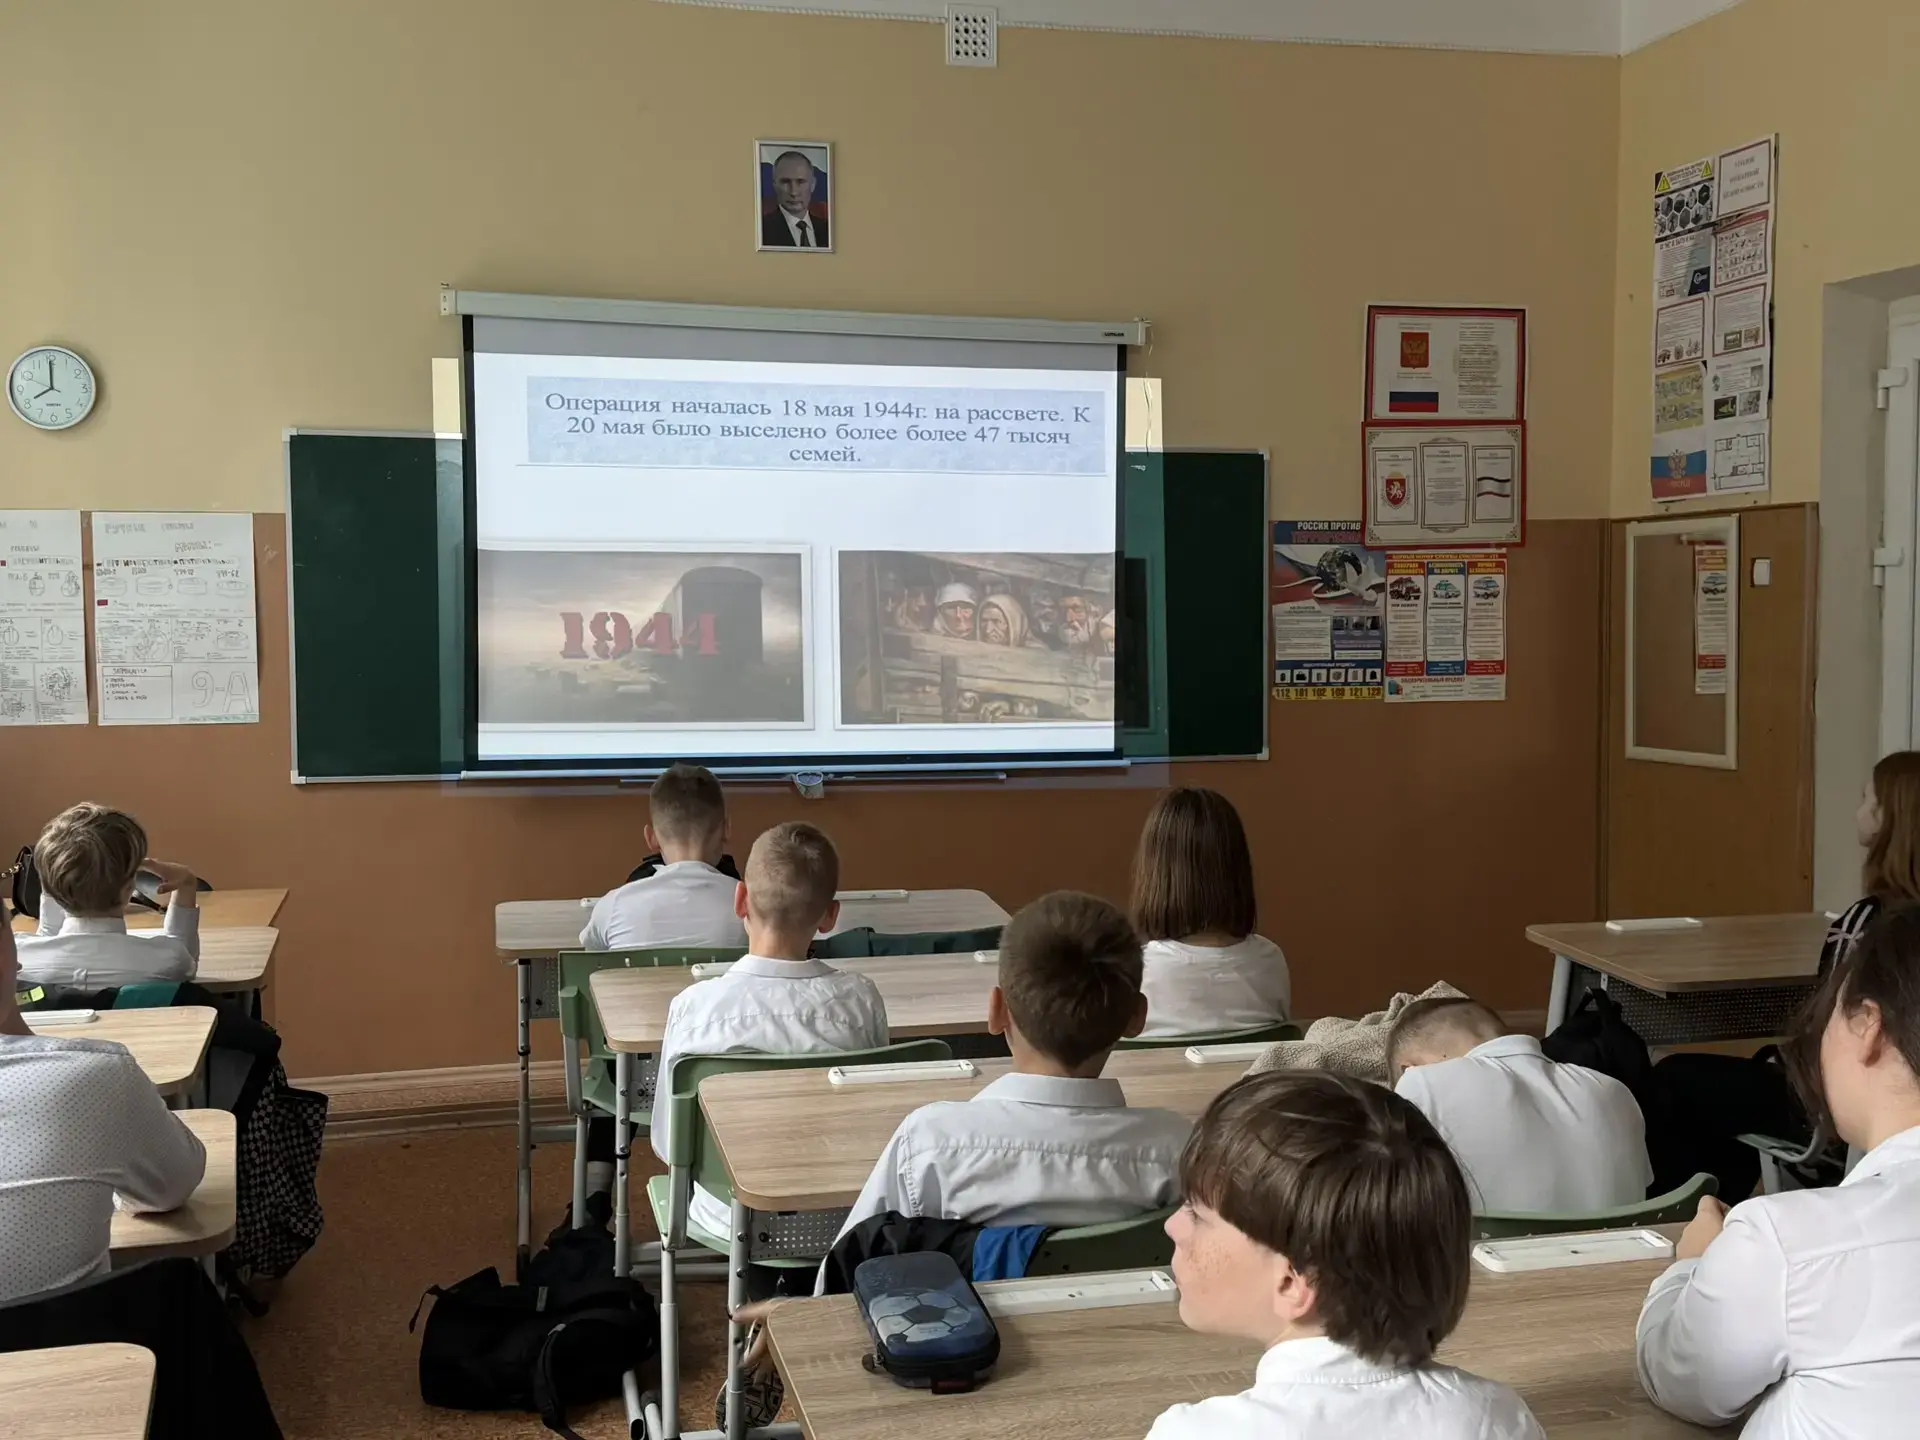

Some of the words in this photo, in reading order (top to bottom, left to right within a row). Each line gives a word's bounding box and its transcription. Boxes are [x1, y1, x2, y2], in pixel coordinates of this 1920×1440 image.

[32, 359, 41, 370] 11
[20, 370, 34, 381] 10
[74, 368, 82, 380] 2
[16, 384, 25, 395] 9
[81, 383, 88, 394] 3
[24, 398, 32, 409] 8
[545, 393, 661, 415] Операция
[672, 400, 772, 415] началась
[783, 400, 807, 416] 18
[814, 405, 855, 418] мая
[863, 401, 927, 419] 1944г.
[936, 407, 960, 420] на
[967, 408, 1064, 424] рассвете.
[1074, 406, 1091, 423] К
[36, 408, 44, 419] 7
[50, 412, 58, 423] 6
[65, 408, 73, 419] 5
[566, 417, 596, 434] 20
[602, 422, 646, 435] мая
[652, 419, 711, 436] было
[720, 424, 827, 439] выселено
[836, 424, 898, 441] более
[906, 425, 967, 442] более
[973, 426, 1000, 443] 47
[1006, 430, 1071, 445] тысяч
[789, 446, 861, 462] семей.
[1297, 522, 1329, 531] РОССИЯ
[1330, 522, 1361, 531] ПРОТИВ
[559, 612, 720, 660] 1944
